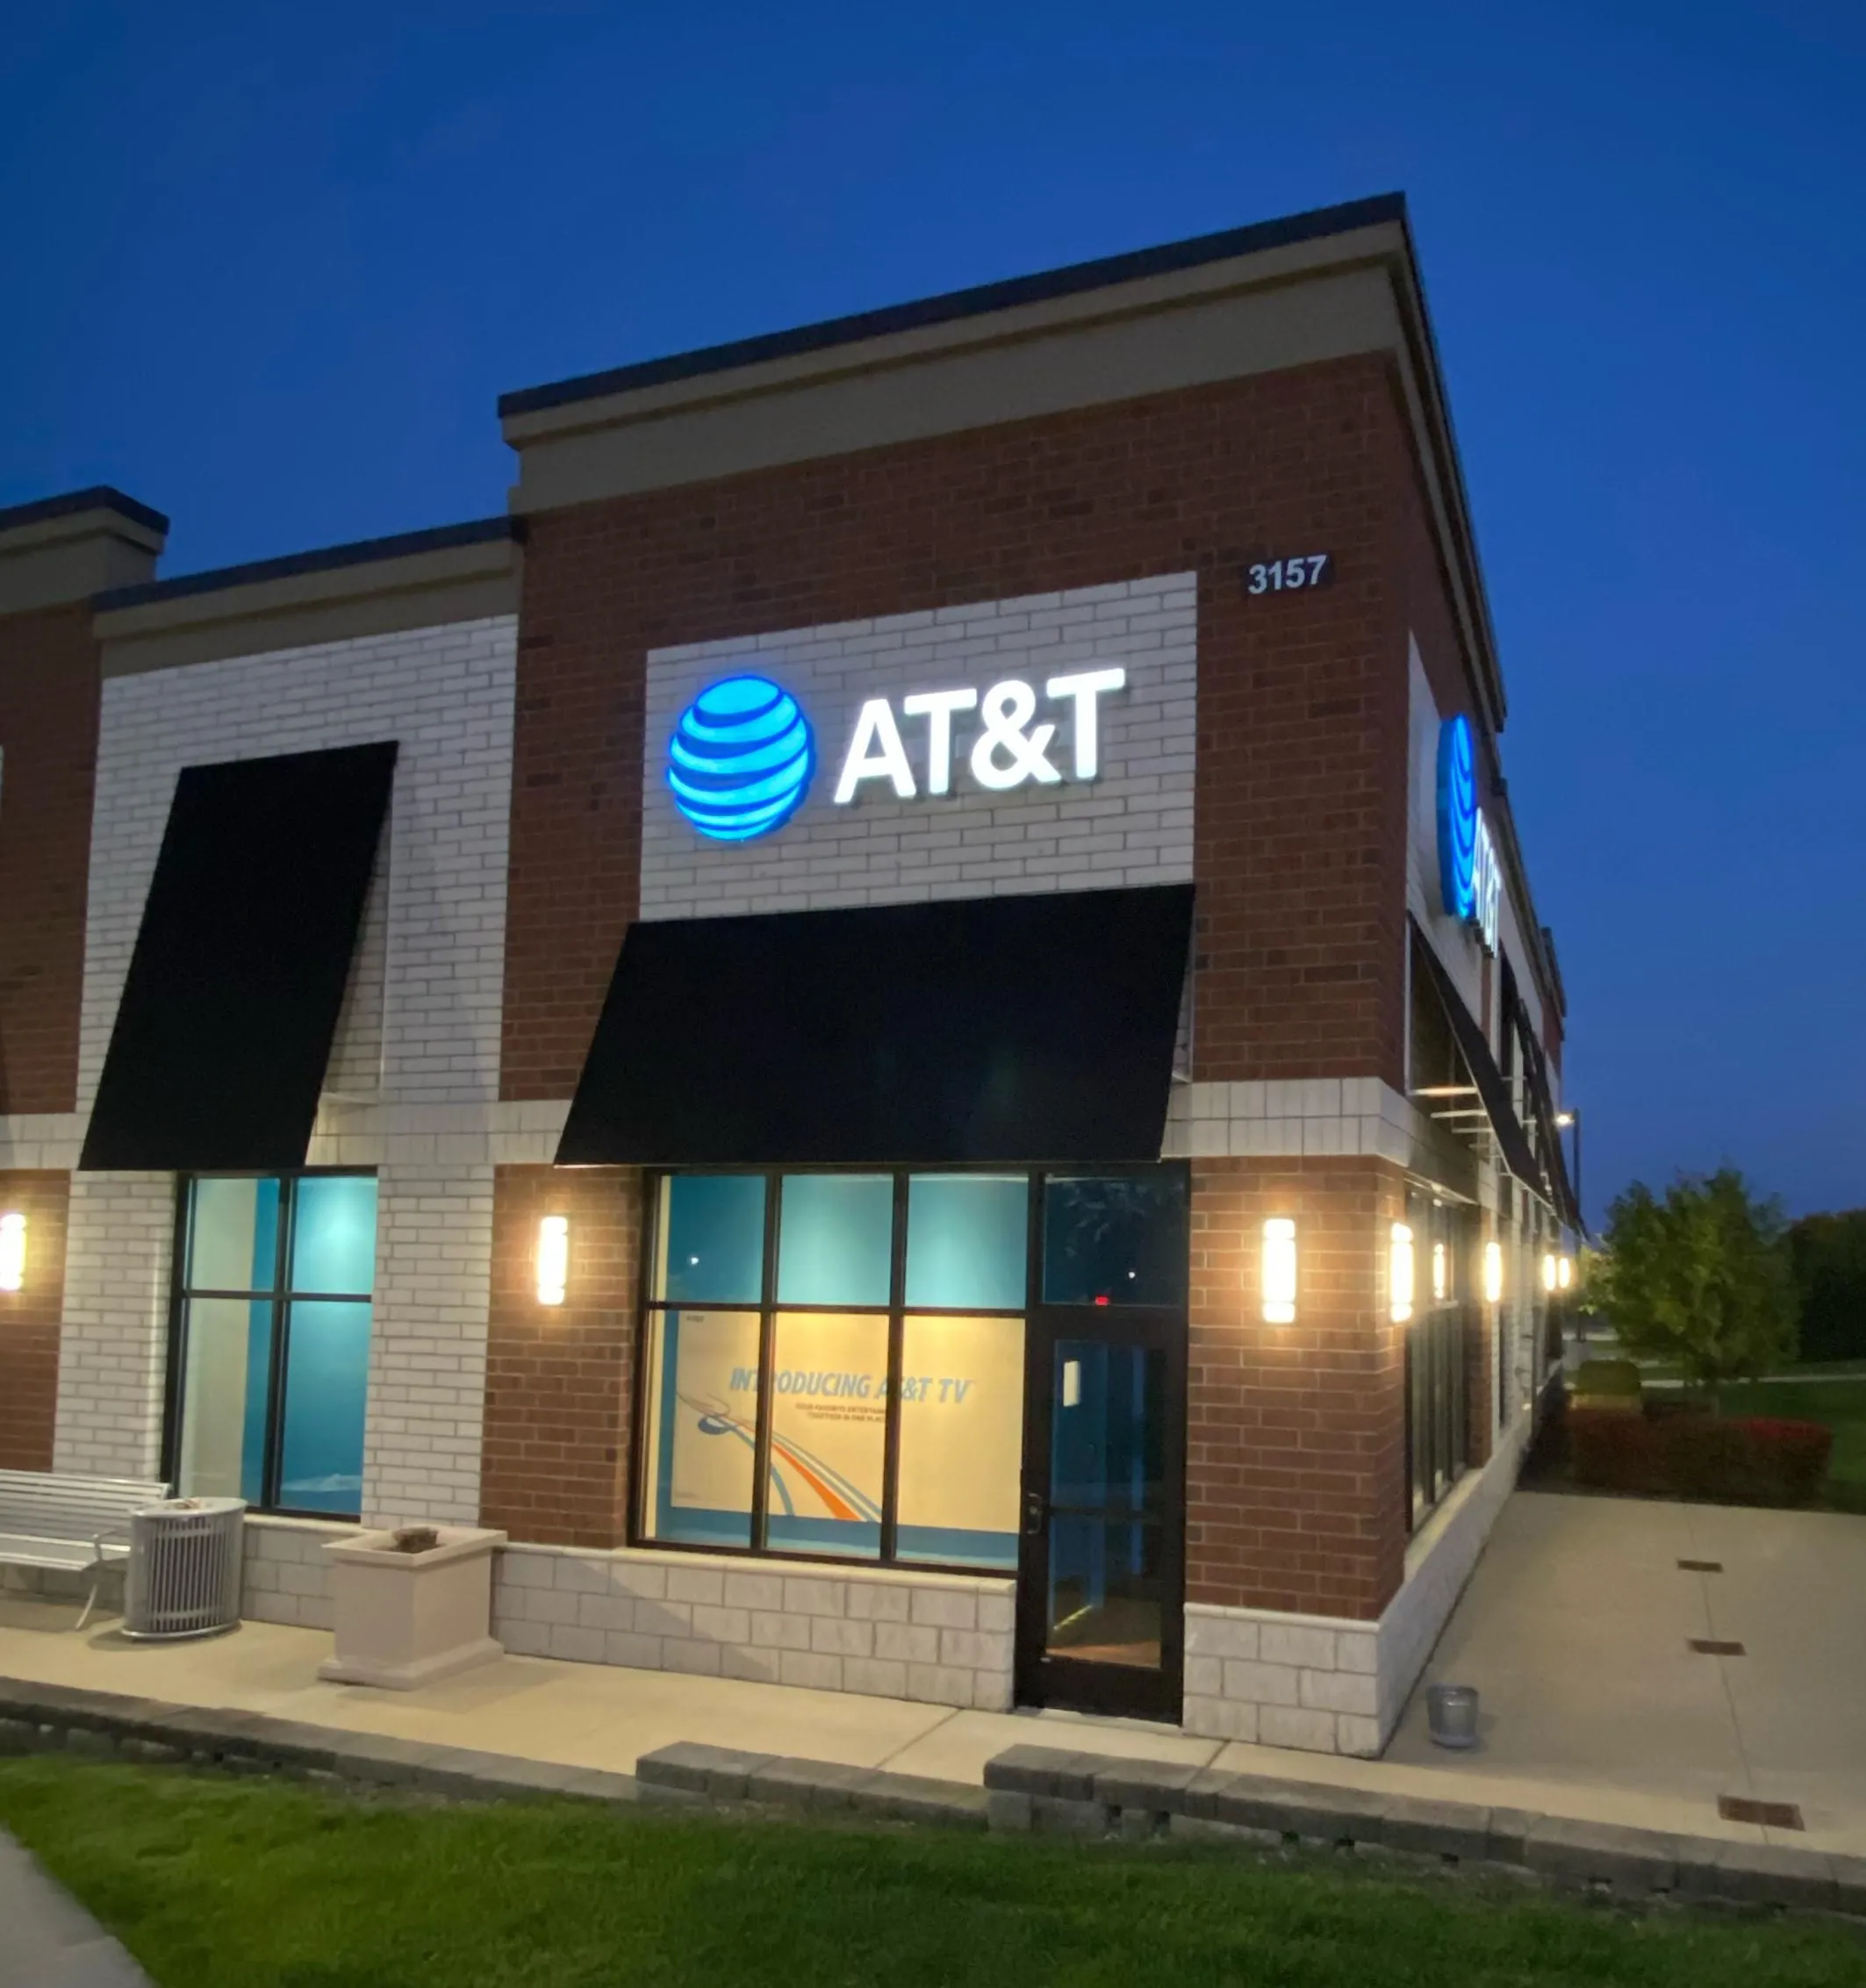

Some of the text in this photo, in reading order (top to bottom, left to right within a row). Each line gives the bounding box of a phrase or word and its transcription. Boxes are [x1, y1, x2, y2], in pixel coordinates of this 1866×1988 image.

[1248, 555, 1328, 594] 3157
[833, 667, 1125, 804] AT&T
[938, 1378, 970, 1404] TV
